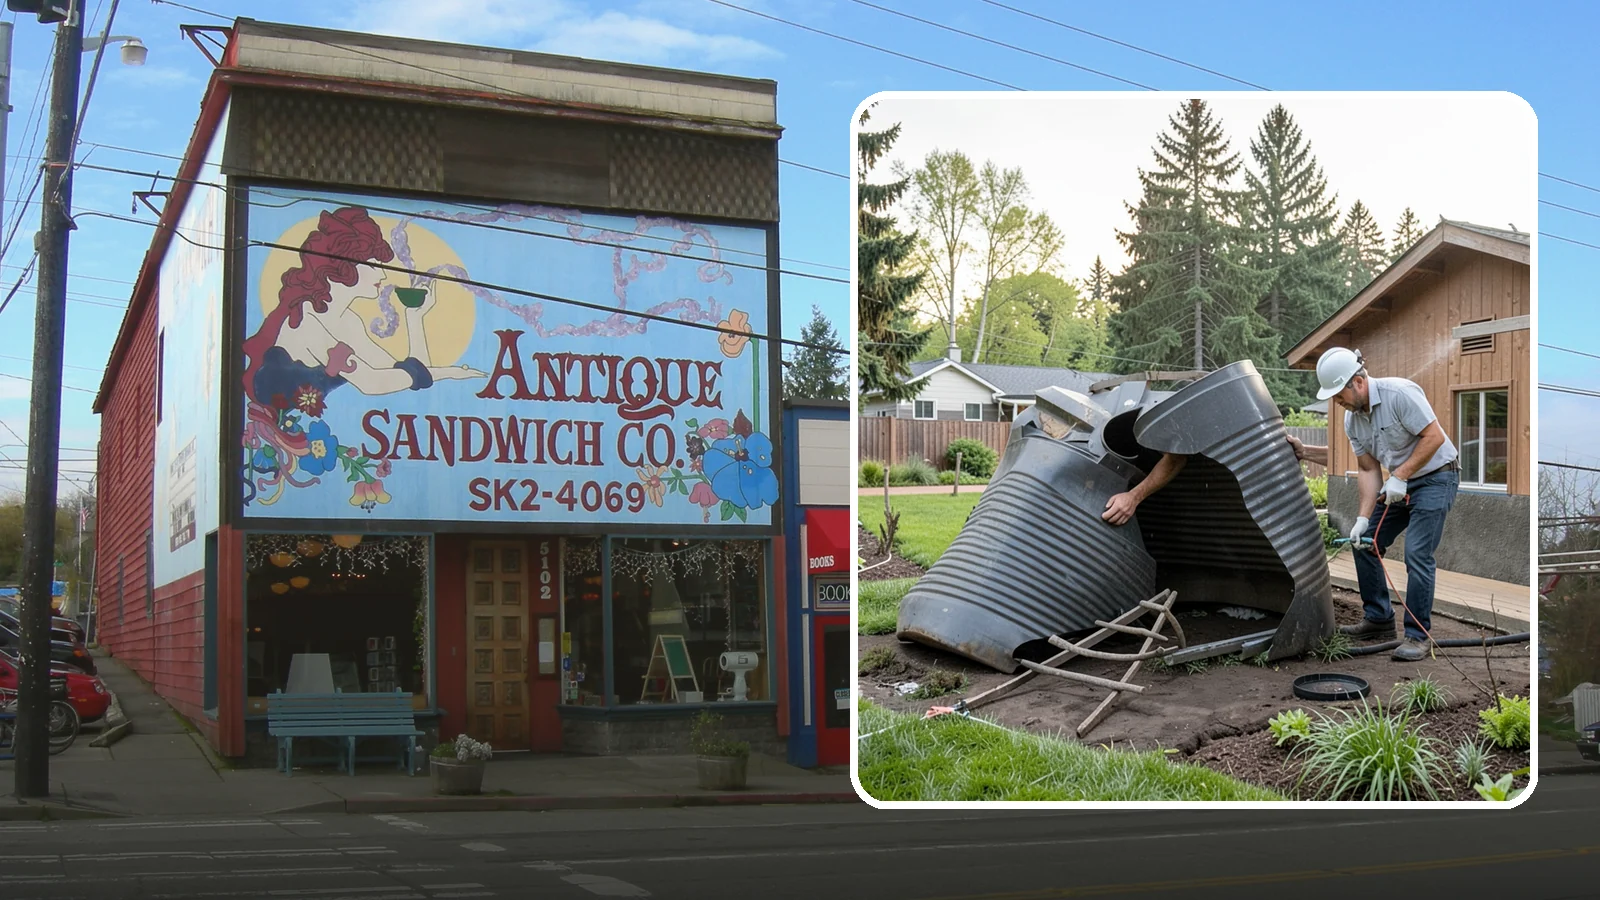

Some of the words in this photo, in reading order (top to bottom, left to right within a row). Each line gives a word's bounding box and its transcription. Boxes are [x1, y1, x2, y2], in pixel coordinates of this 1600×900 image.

[361, 408, 604, 467] SANDWICH
[617, 422, 686, 469] CO.
[468, 477, 645, 512] SK2-4069
[540, 541, 552, 600] 5102
[810, 555, 835, 569] BOOKS
